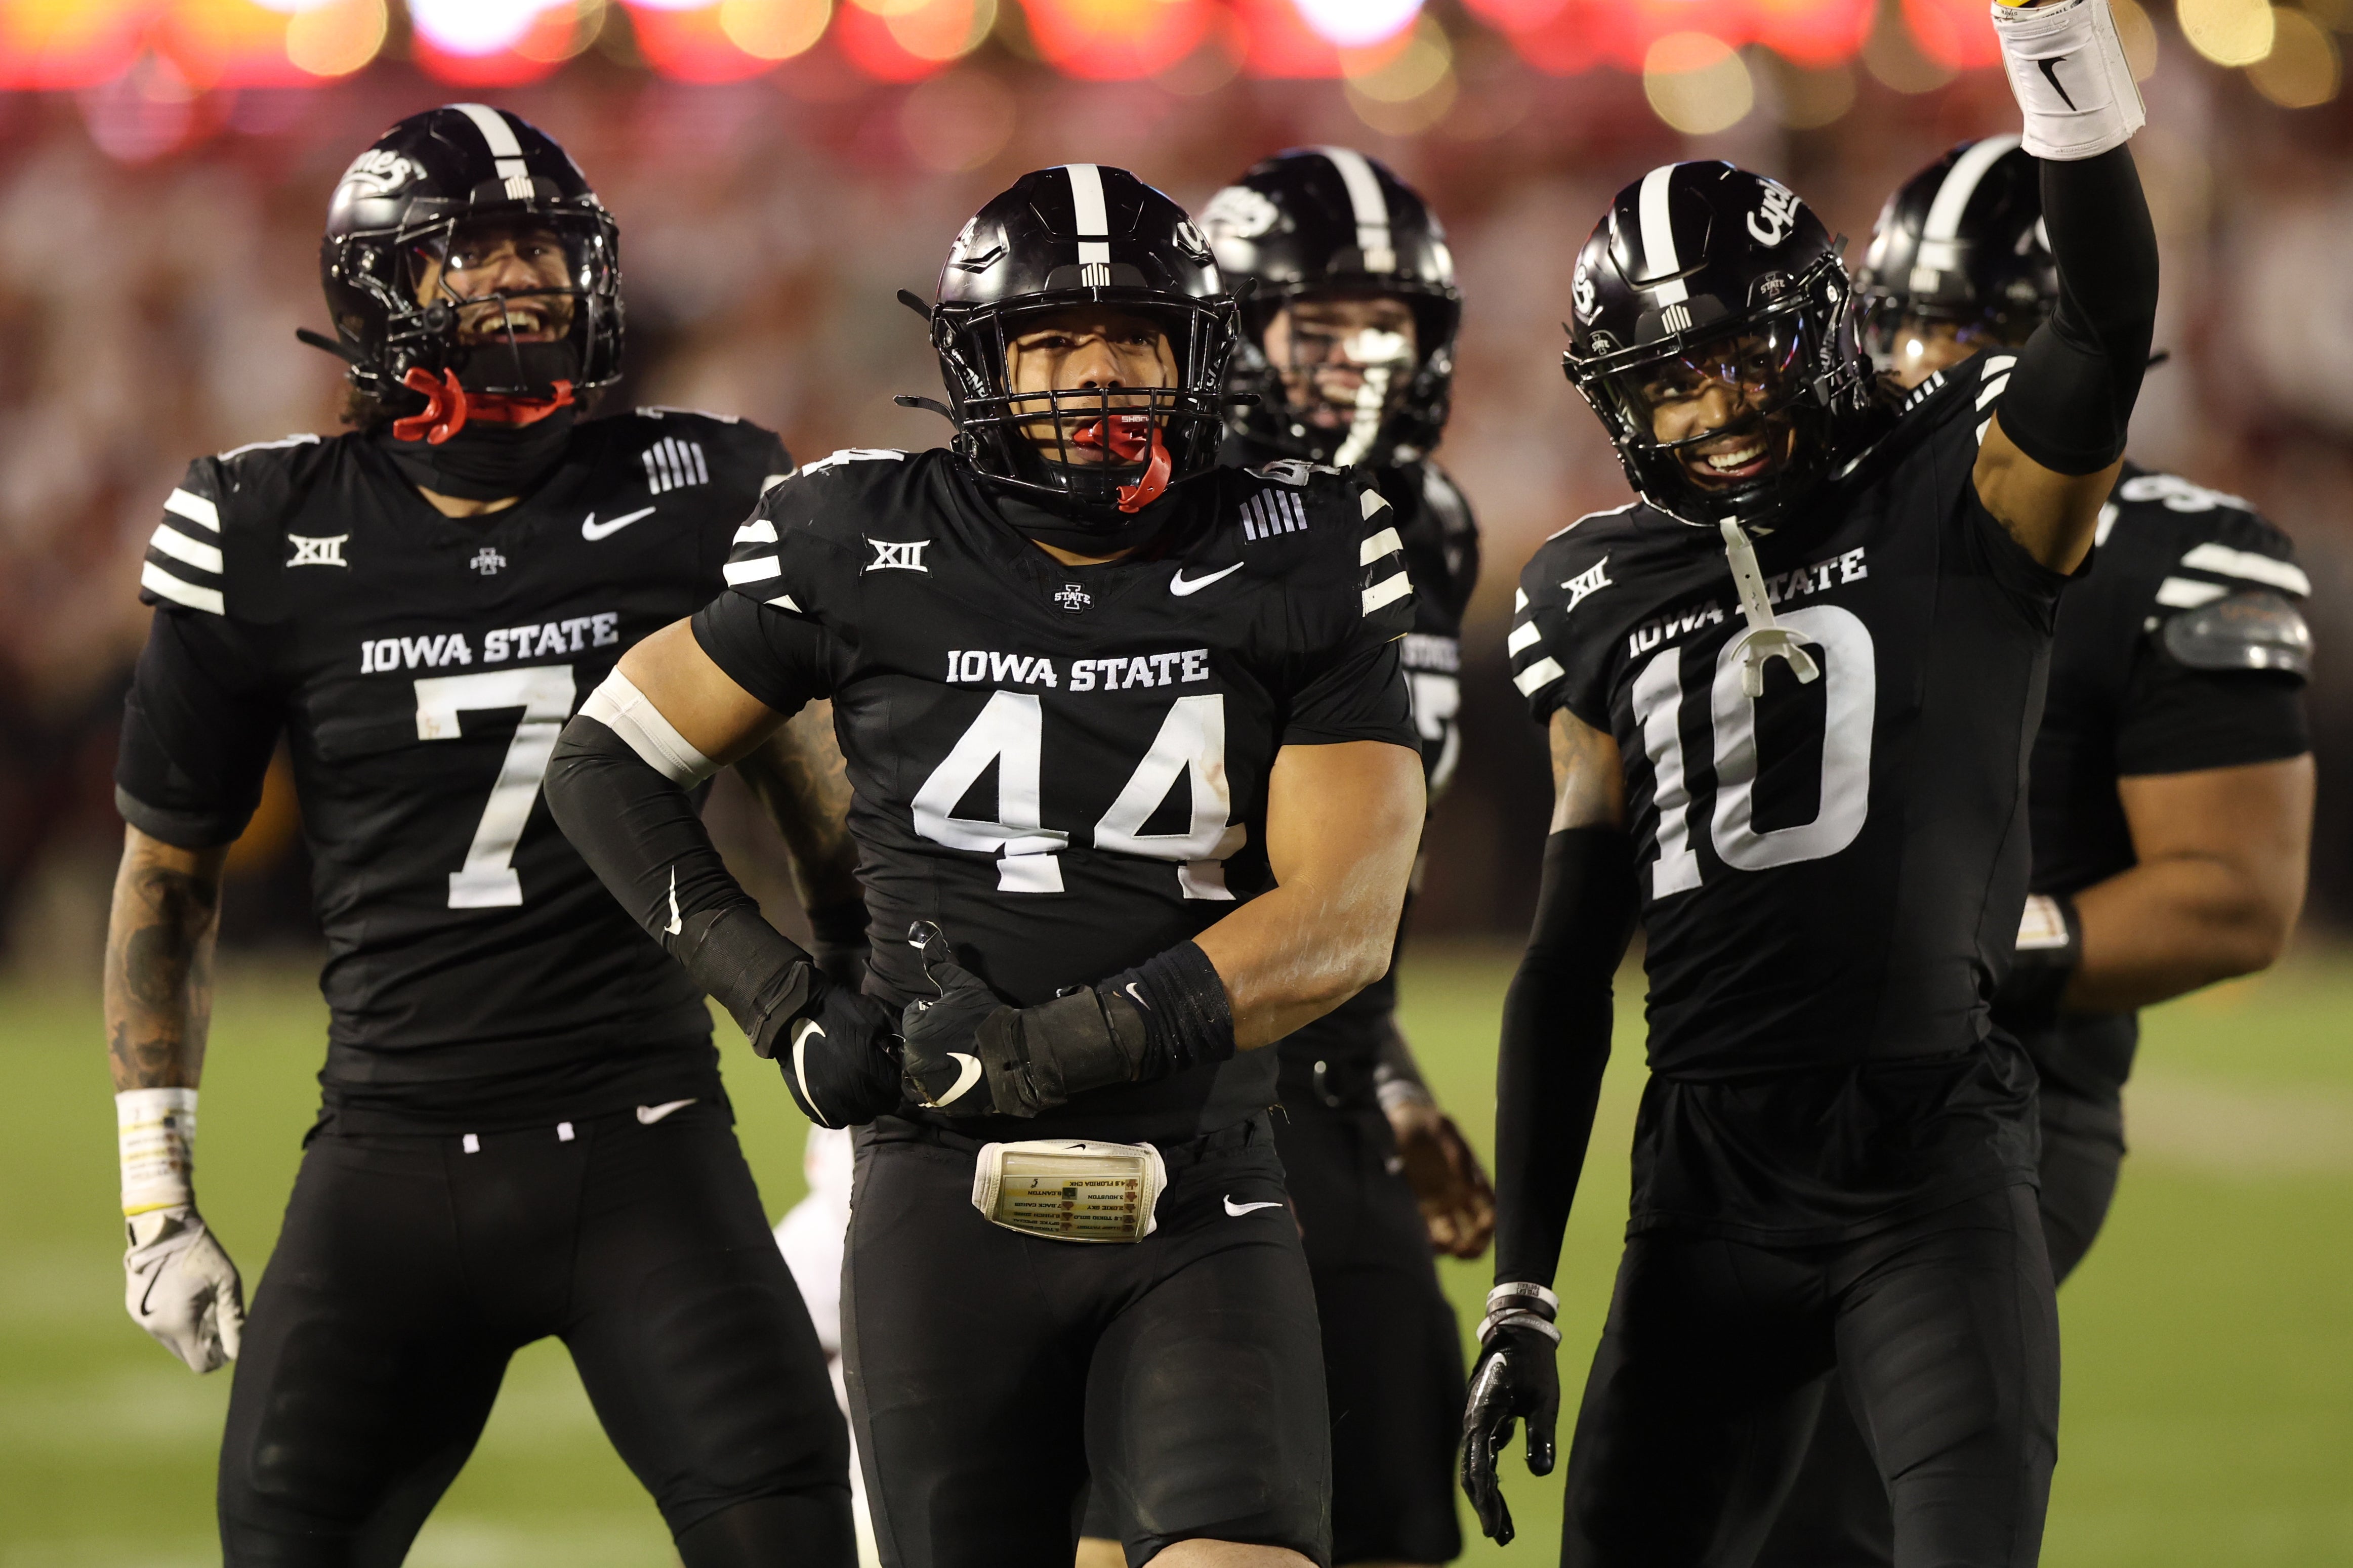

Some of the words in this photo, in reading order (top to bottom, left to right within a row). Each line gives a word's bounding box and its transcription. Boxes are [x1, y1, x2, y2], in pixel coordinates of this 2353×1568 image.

[1760, 279, 1785, 294] STATE
[286, 534, 349, 567] XII
[865, 538, 931, 572] XII
[1054, 592, 1091, 604] STATE
[1629, 599, 1724, 659] IOWA
[1735, 546, 1868, 615] TATE
[361, 632, 472, 673] IOWA
[483, 612, 618, 664] STATE
[946, 650, 1057, 688] IOWA
[1069, 648, 1209, 692] STATE
[1627, 605, 1876, 900] 10
[414, 664, 577, 909] 7
[911, 690, 1247, 900] 44
